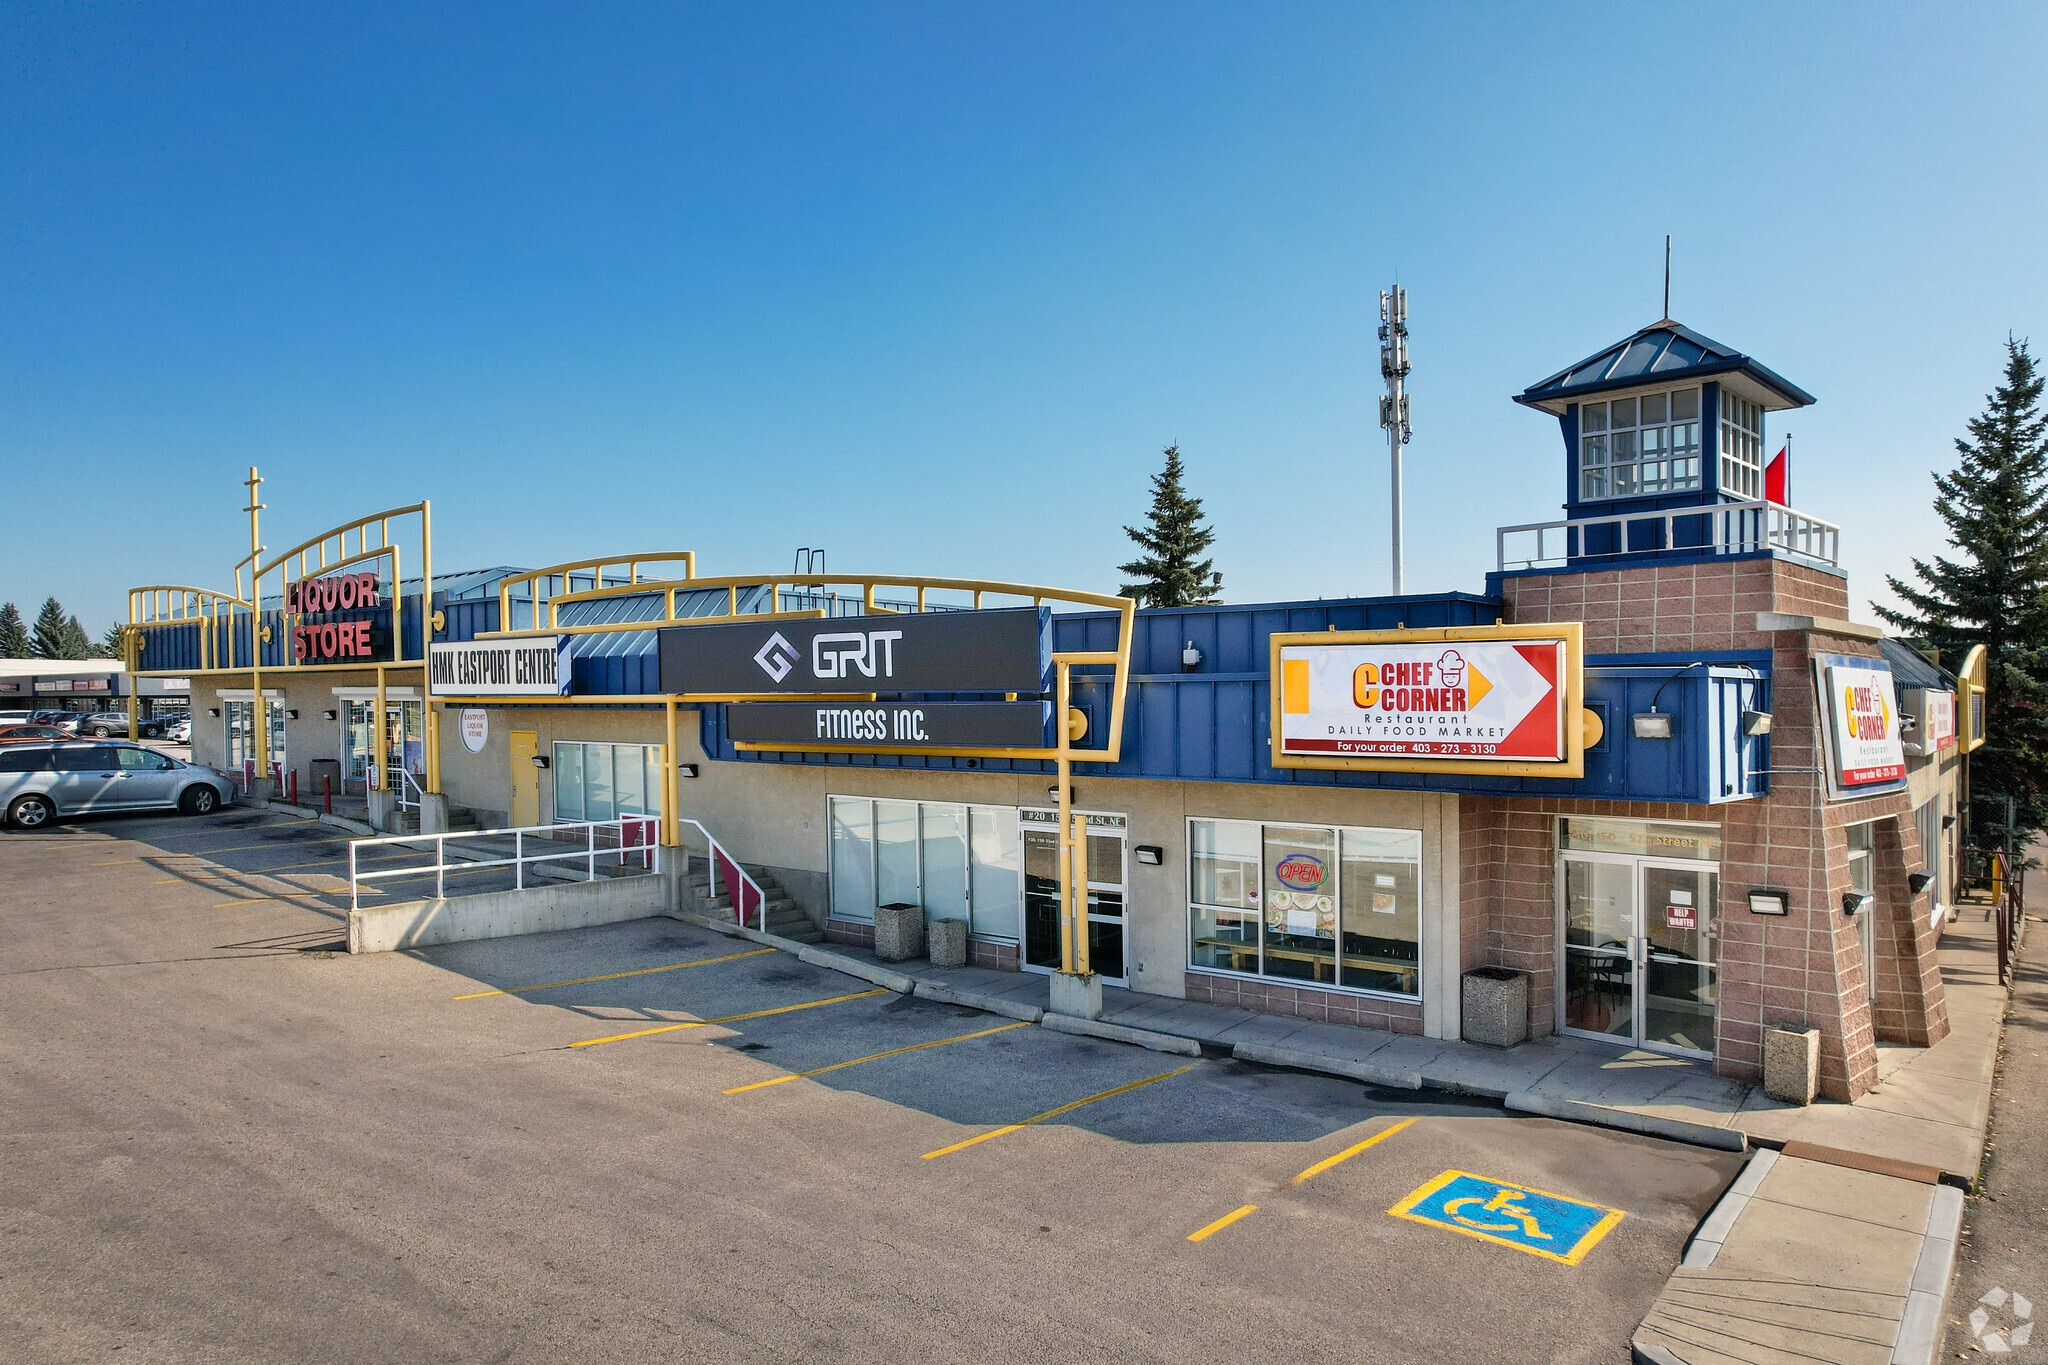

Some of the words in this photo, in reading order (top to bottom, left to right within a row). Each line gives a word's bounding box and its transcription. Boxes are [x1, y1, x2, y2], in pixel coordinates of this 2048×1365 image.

[286, 572, 374, 614] LIQUOR
[292, 620, 372, 659] STORE
[812, 630, 903, 678] GRIT
[432, 651, 455, 685] HMK
[457, 649, 511, 685] EASTPORT
[515, 648, 557, 685] CENTRE
[1381, 662, 1433, 686] CHEF
[1381, 688, 1466, 712] CORNER
[1854, 686, 1872, 713] CHEF
[464, 713, 486, 721] EASTPORT
[1364, 714, 1468, 724] Restaurant
[466, 722, 484, 730] LIQUOR
[1328, 726, 1372, 735] DAILY
[1383, 727, 1427, 736] FOOD
[1438, 727, 1505, 737] MARKET
[1857, 715, 1886, 741] CORNER
[468, 730, 482, 738] STORE
[1337, 741, 1351, 751] For
[1354, 744, 1376, 754] your
[1379, 742, 1406, 752] order
[1411, 743, 1431, 753] 403
[1440, 744, 1460, 754] 273
[1470, 744, 1496, 754] 3130
[1028, 811, 1045, 821] #20
[1095, 816, 1107, 825] St.
[1109, 817, 1121, 826] NE
[1656, 835, 1694, 847] Street
[1278, 862, 1325, 883] OPEN
[1673, 908, 1689, 917] HELP
[1669, 917, 1694, 928] WANTED
